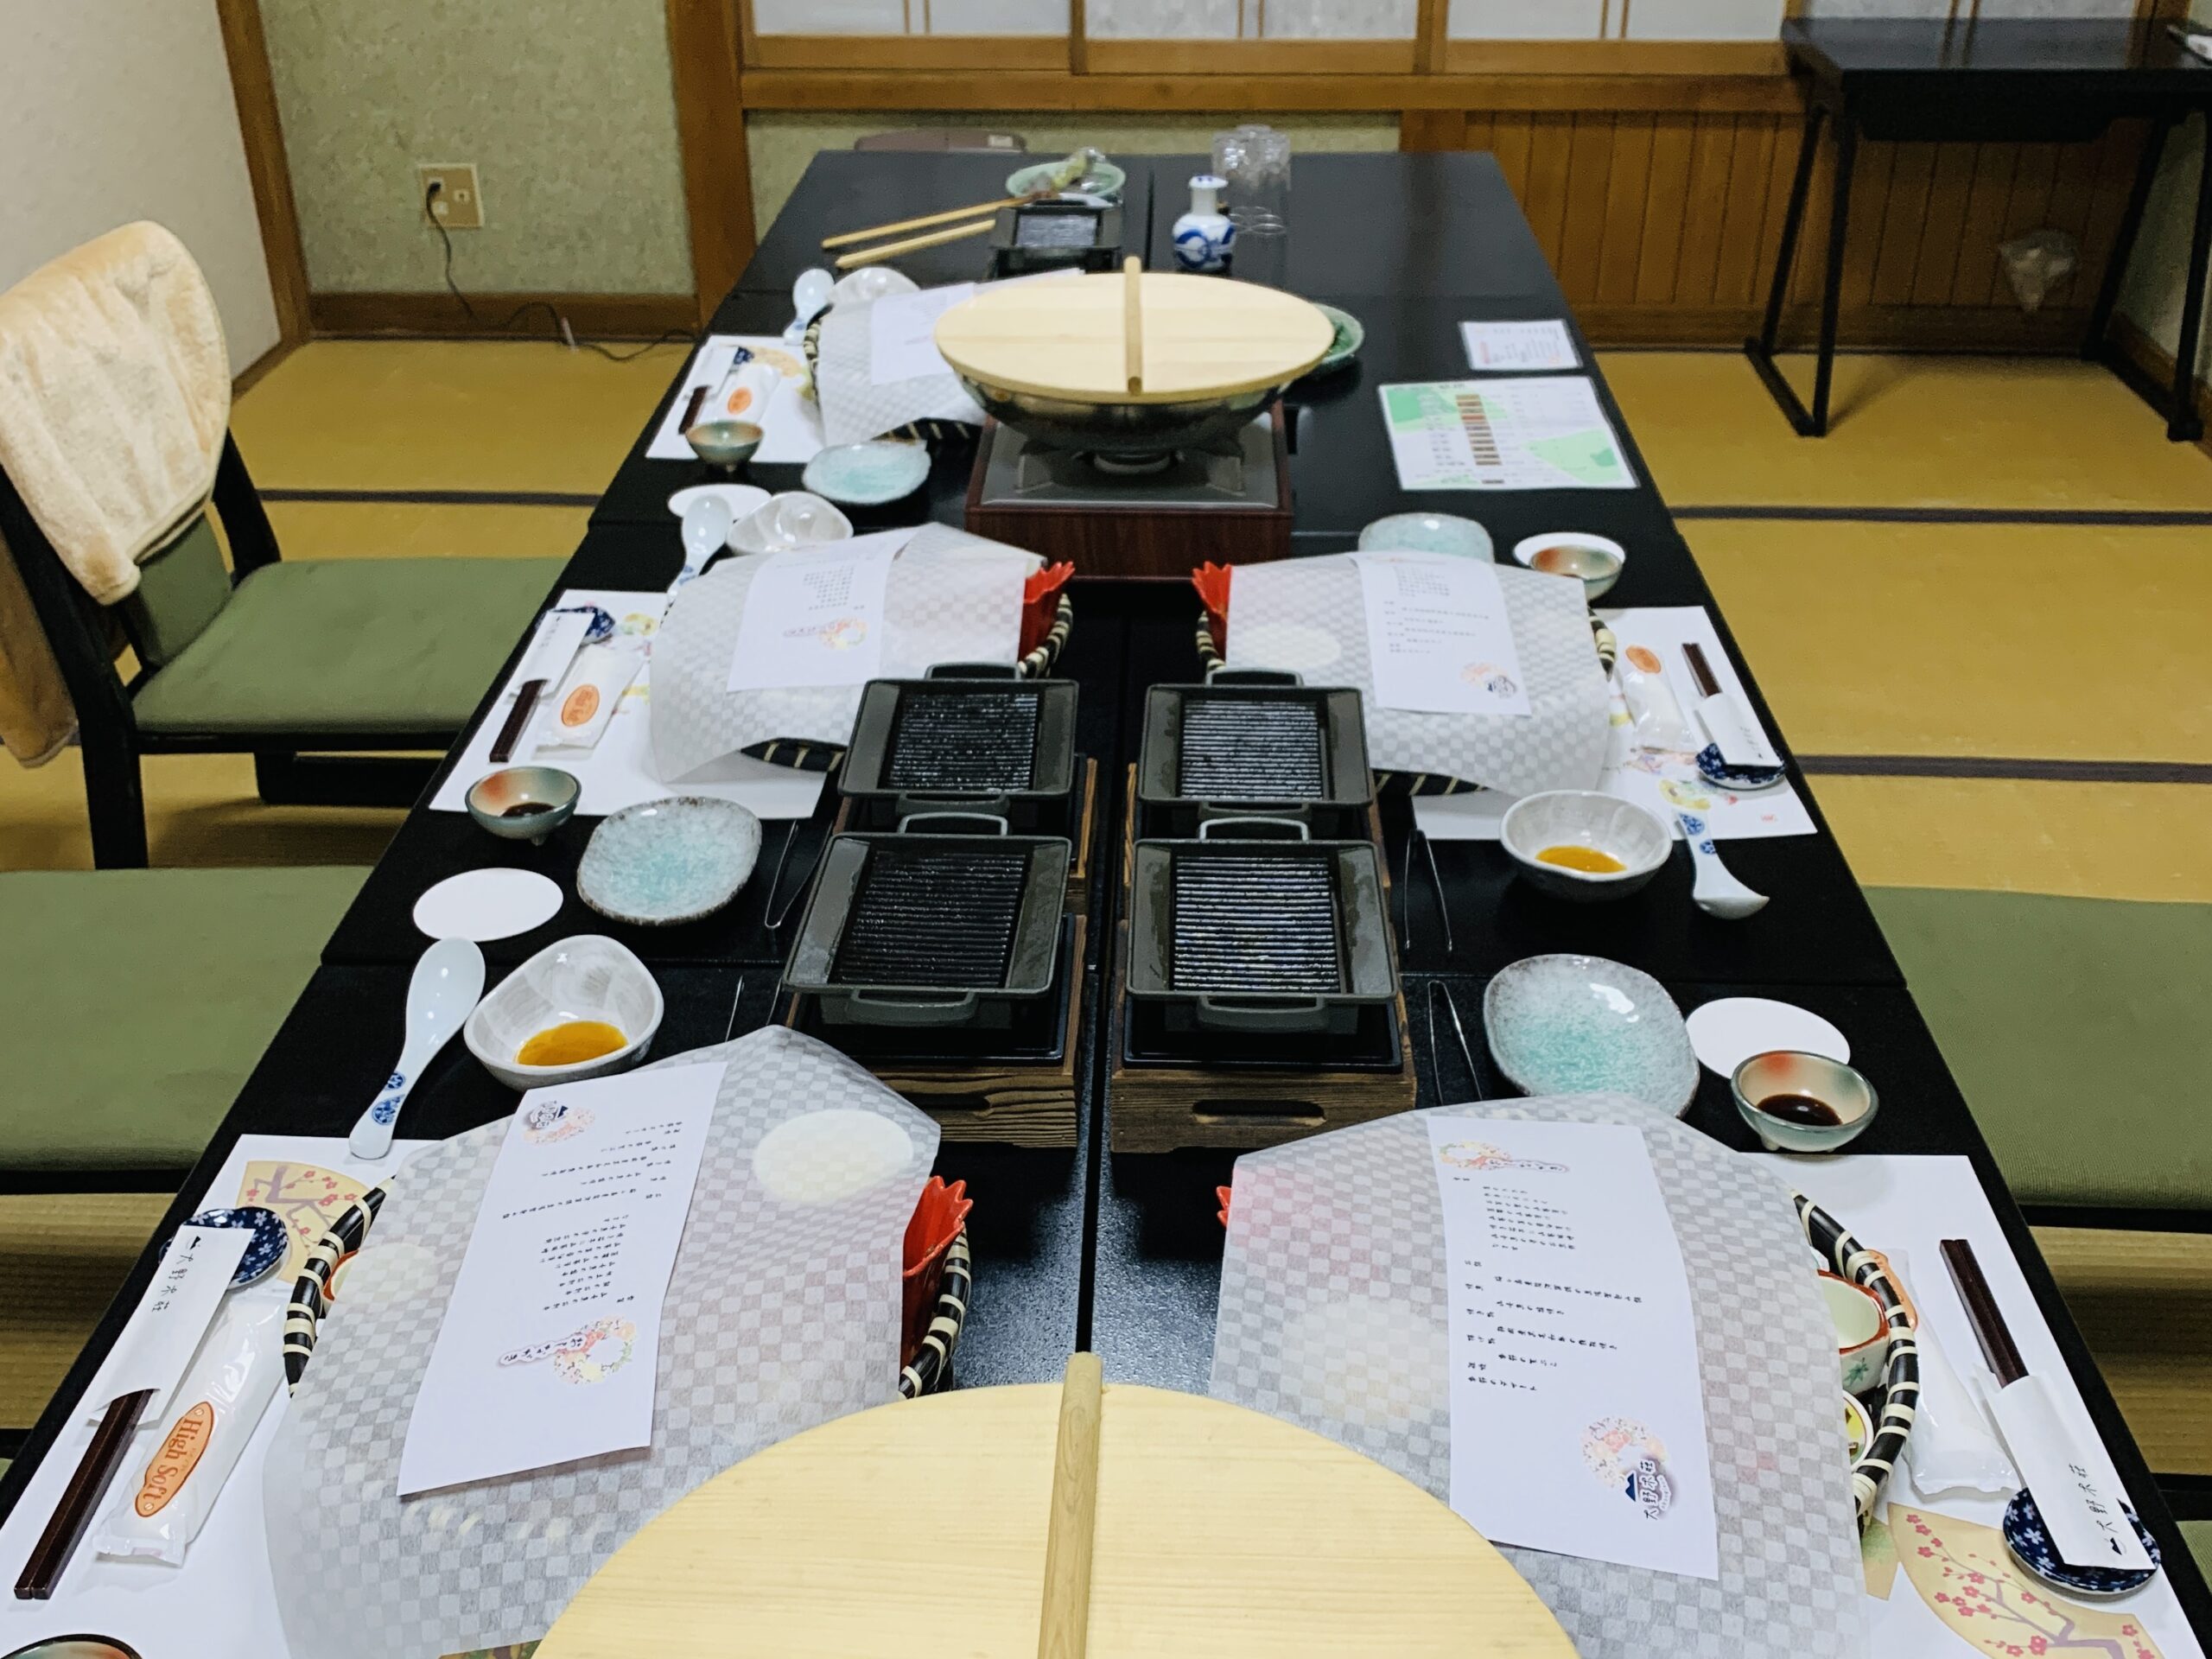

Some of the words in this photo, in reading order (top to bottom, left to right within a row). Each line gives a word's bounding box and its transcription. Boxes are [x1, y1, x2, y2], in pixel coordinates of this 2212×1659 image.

[151, 1253, 195, 1313] 大野木荘
[165, 1418, 204, 1460] High
[143, 1465, 179, 1501] Soft
[1640, 1461, 1658, 1521] 大野木荘
[2069, 1463, 2119, 1533] 大野木荘
